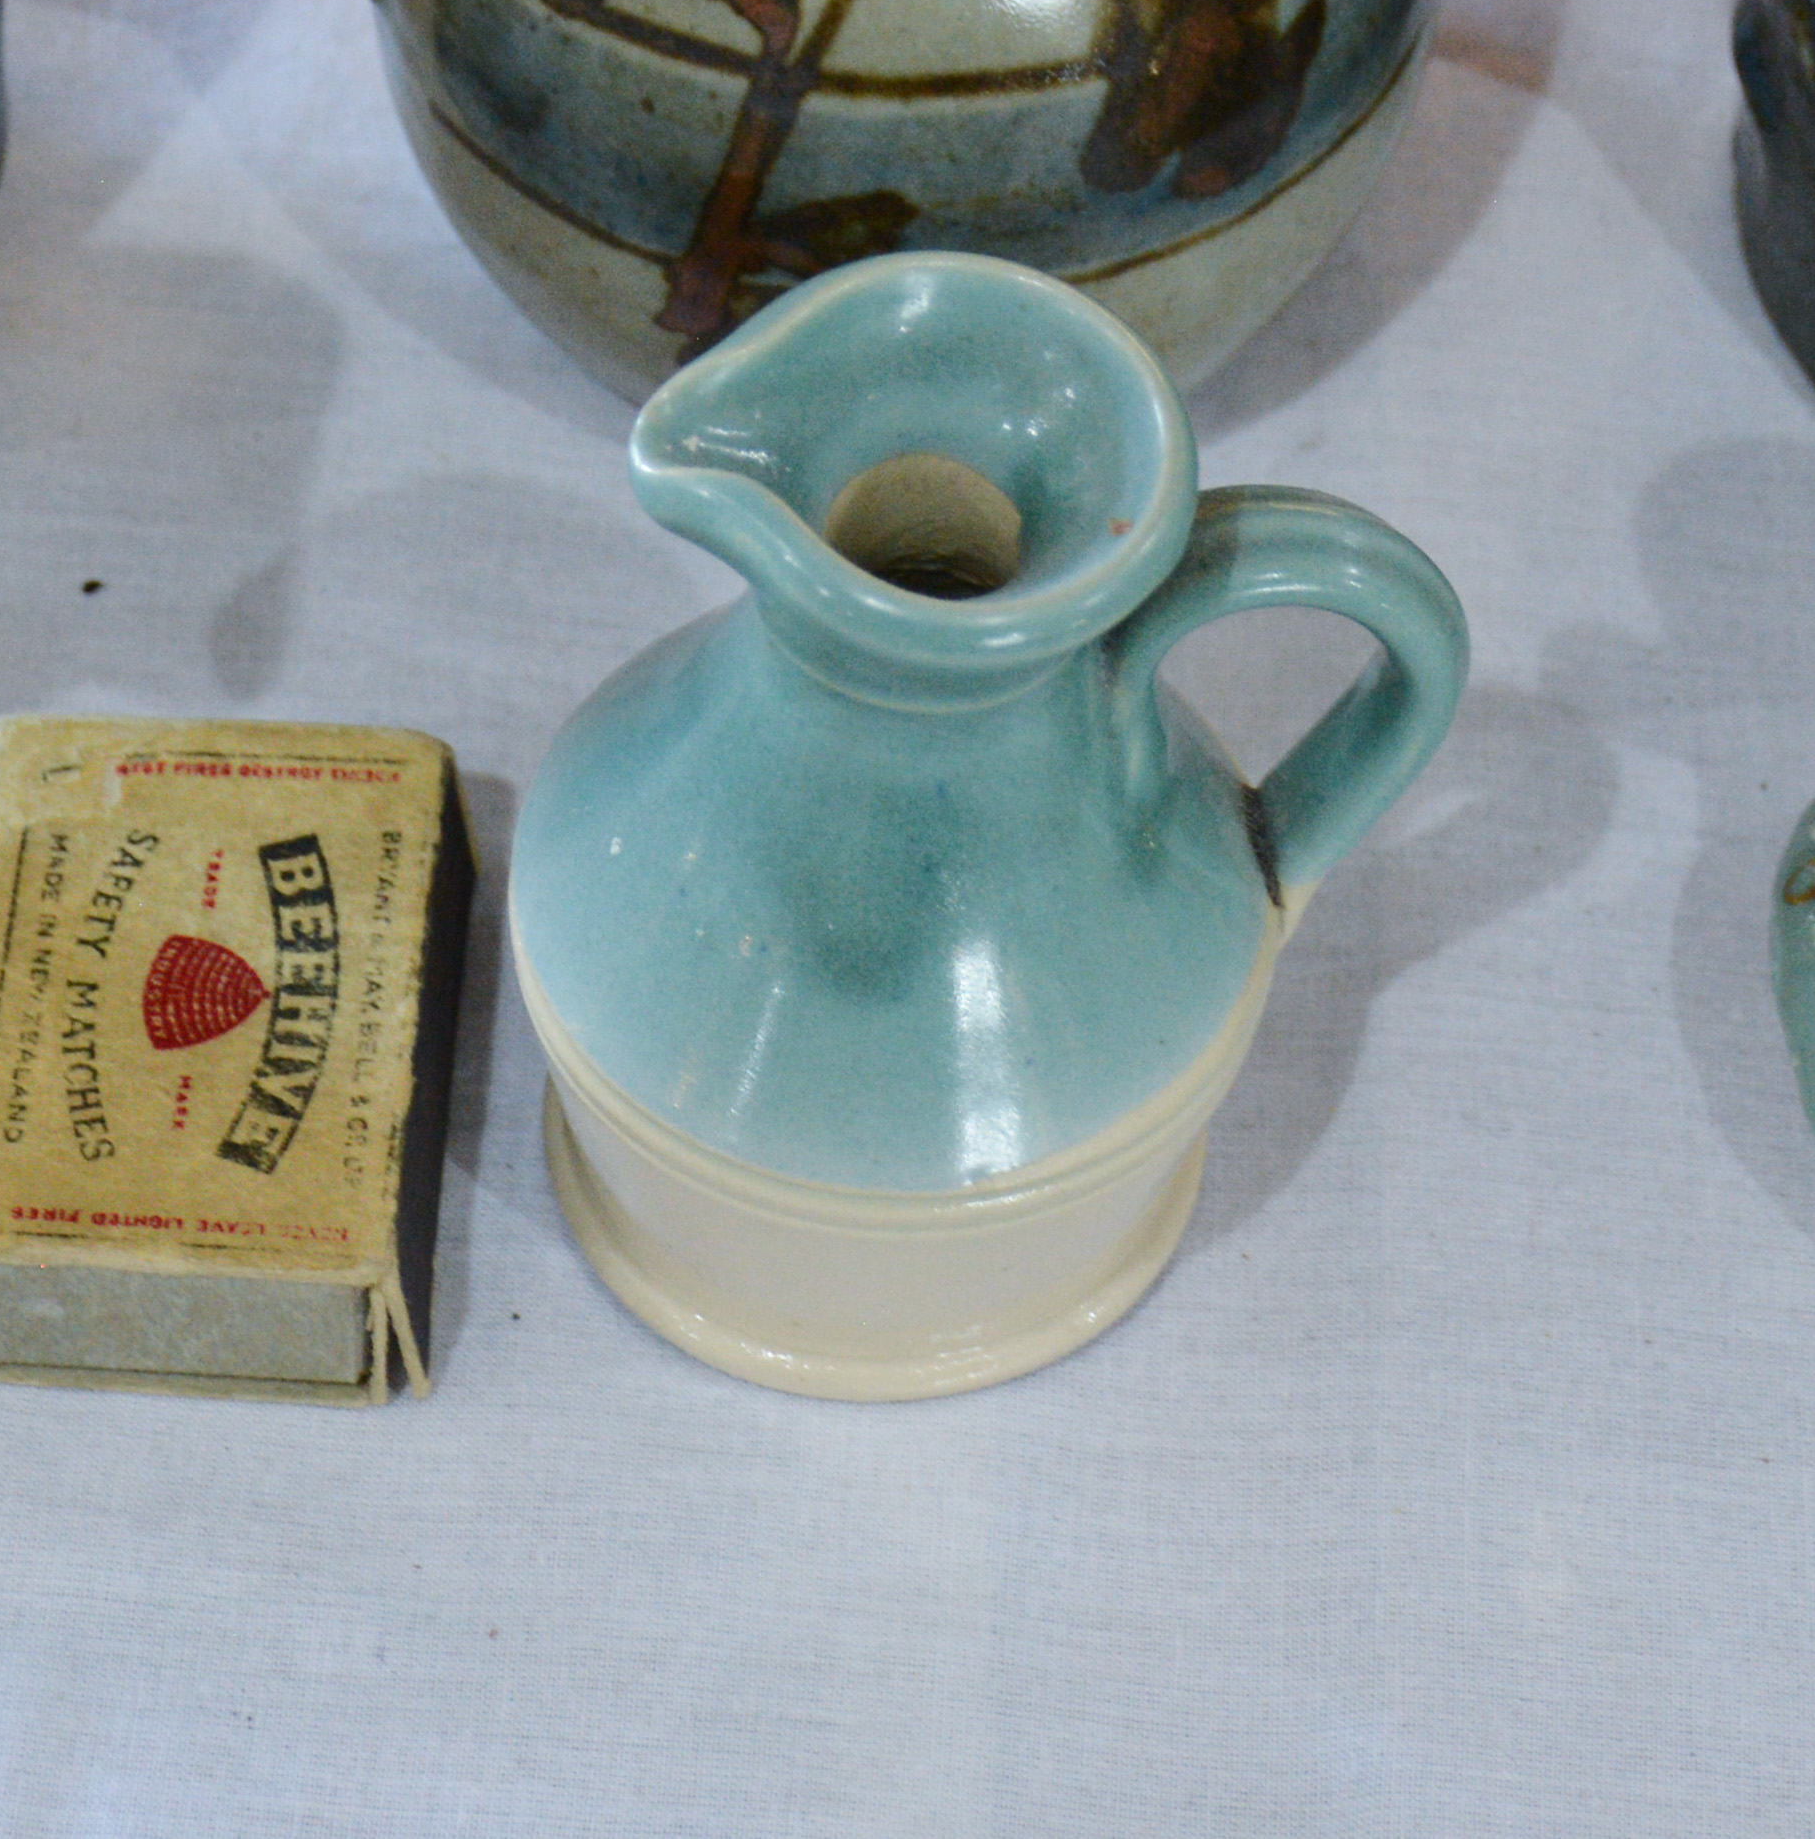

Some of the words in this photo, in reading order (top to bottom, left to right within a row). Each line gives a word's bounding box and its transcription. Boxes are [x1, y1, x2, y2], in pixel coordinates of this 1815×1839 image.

[39, 832, 70, 903] MADE
[76, 828, 161, 959] SAFETY
[202, 849, 224, 910] TRADE
[37, 914, 58, 939] IN
[28, 948, 52, 1004] NEW
[147, 939, 182, 1039] INDUSTRY
[231, 849, 338, 1157] BEEHIVE
[3, 1011, 44, 1145] ZEALAND
[61, 978, 116, 1163] MATCHES
[173, 1075, 193, 1130] MARK
[10, 1205, 82, 1224] FIRES
[89, 1210, 184, 1231] LIGHTED
[195, 1219, 266, 1237] LEAVE
